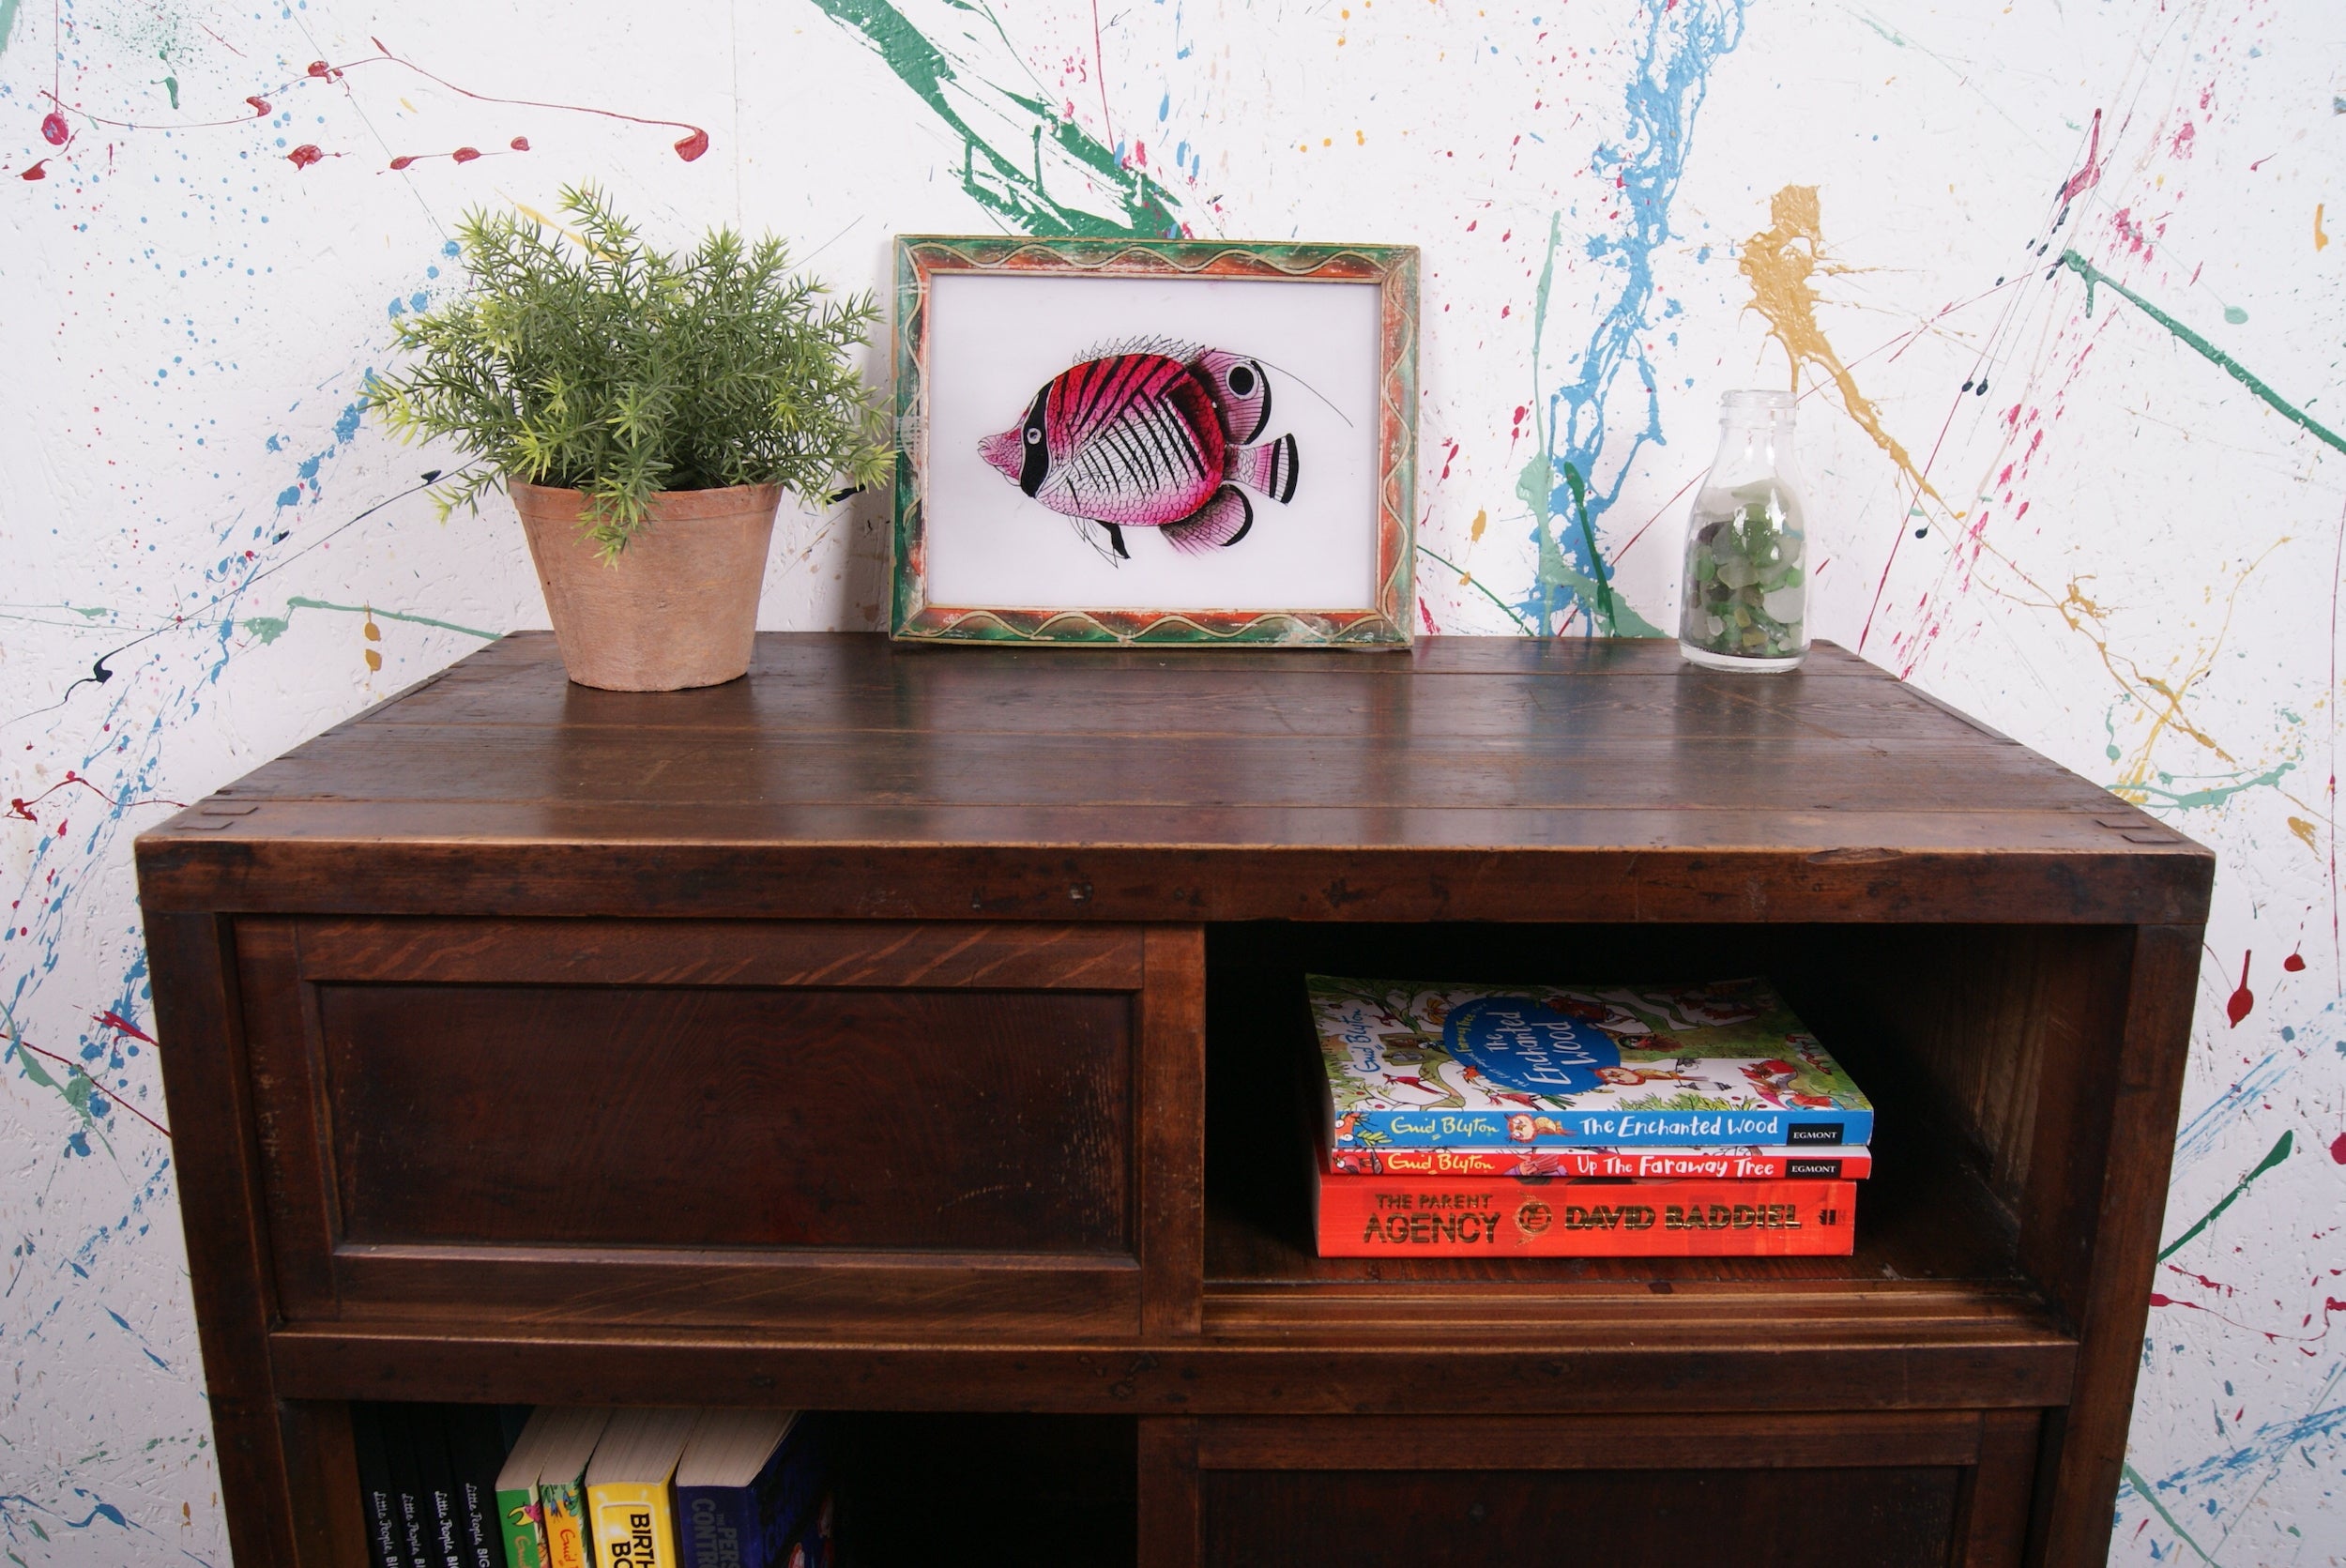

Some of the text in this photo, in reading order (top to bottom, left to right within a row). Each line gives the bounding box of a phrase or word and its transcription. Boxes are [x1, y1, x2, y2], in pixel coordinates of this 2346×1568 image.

[1341, 1008, 1381, 1073] Enid Blyton
[1485, 1011, 1572, 1085] Enchanted
[1390, 1115, 1779, 1137] Enid Blyton The Enchanted Wood
[1792, 1131, 1838, 1140] EGMONT
[1387, 1152, 1775, 1178] Enid Blyton Up The Faraway Tree
[1790, 1165, 1836, 1174] EGMONT
[1375, 1193, 1494, 1210] THE PARENT
[1363, 1211, 1501, 1244] AGENCY
[1564, 1204, 1803, 1230] DAVID BADDIEL
[373, 1490, 388, 1519] Little
[401, 1493, 415, 1520] Little
[434, 1490, 449, 1518] Little
[465, 1483, 479, 1511] Little
[477, 1547, 490, 1568] BIG
[559, 1529, 578, 1562] Enid
